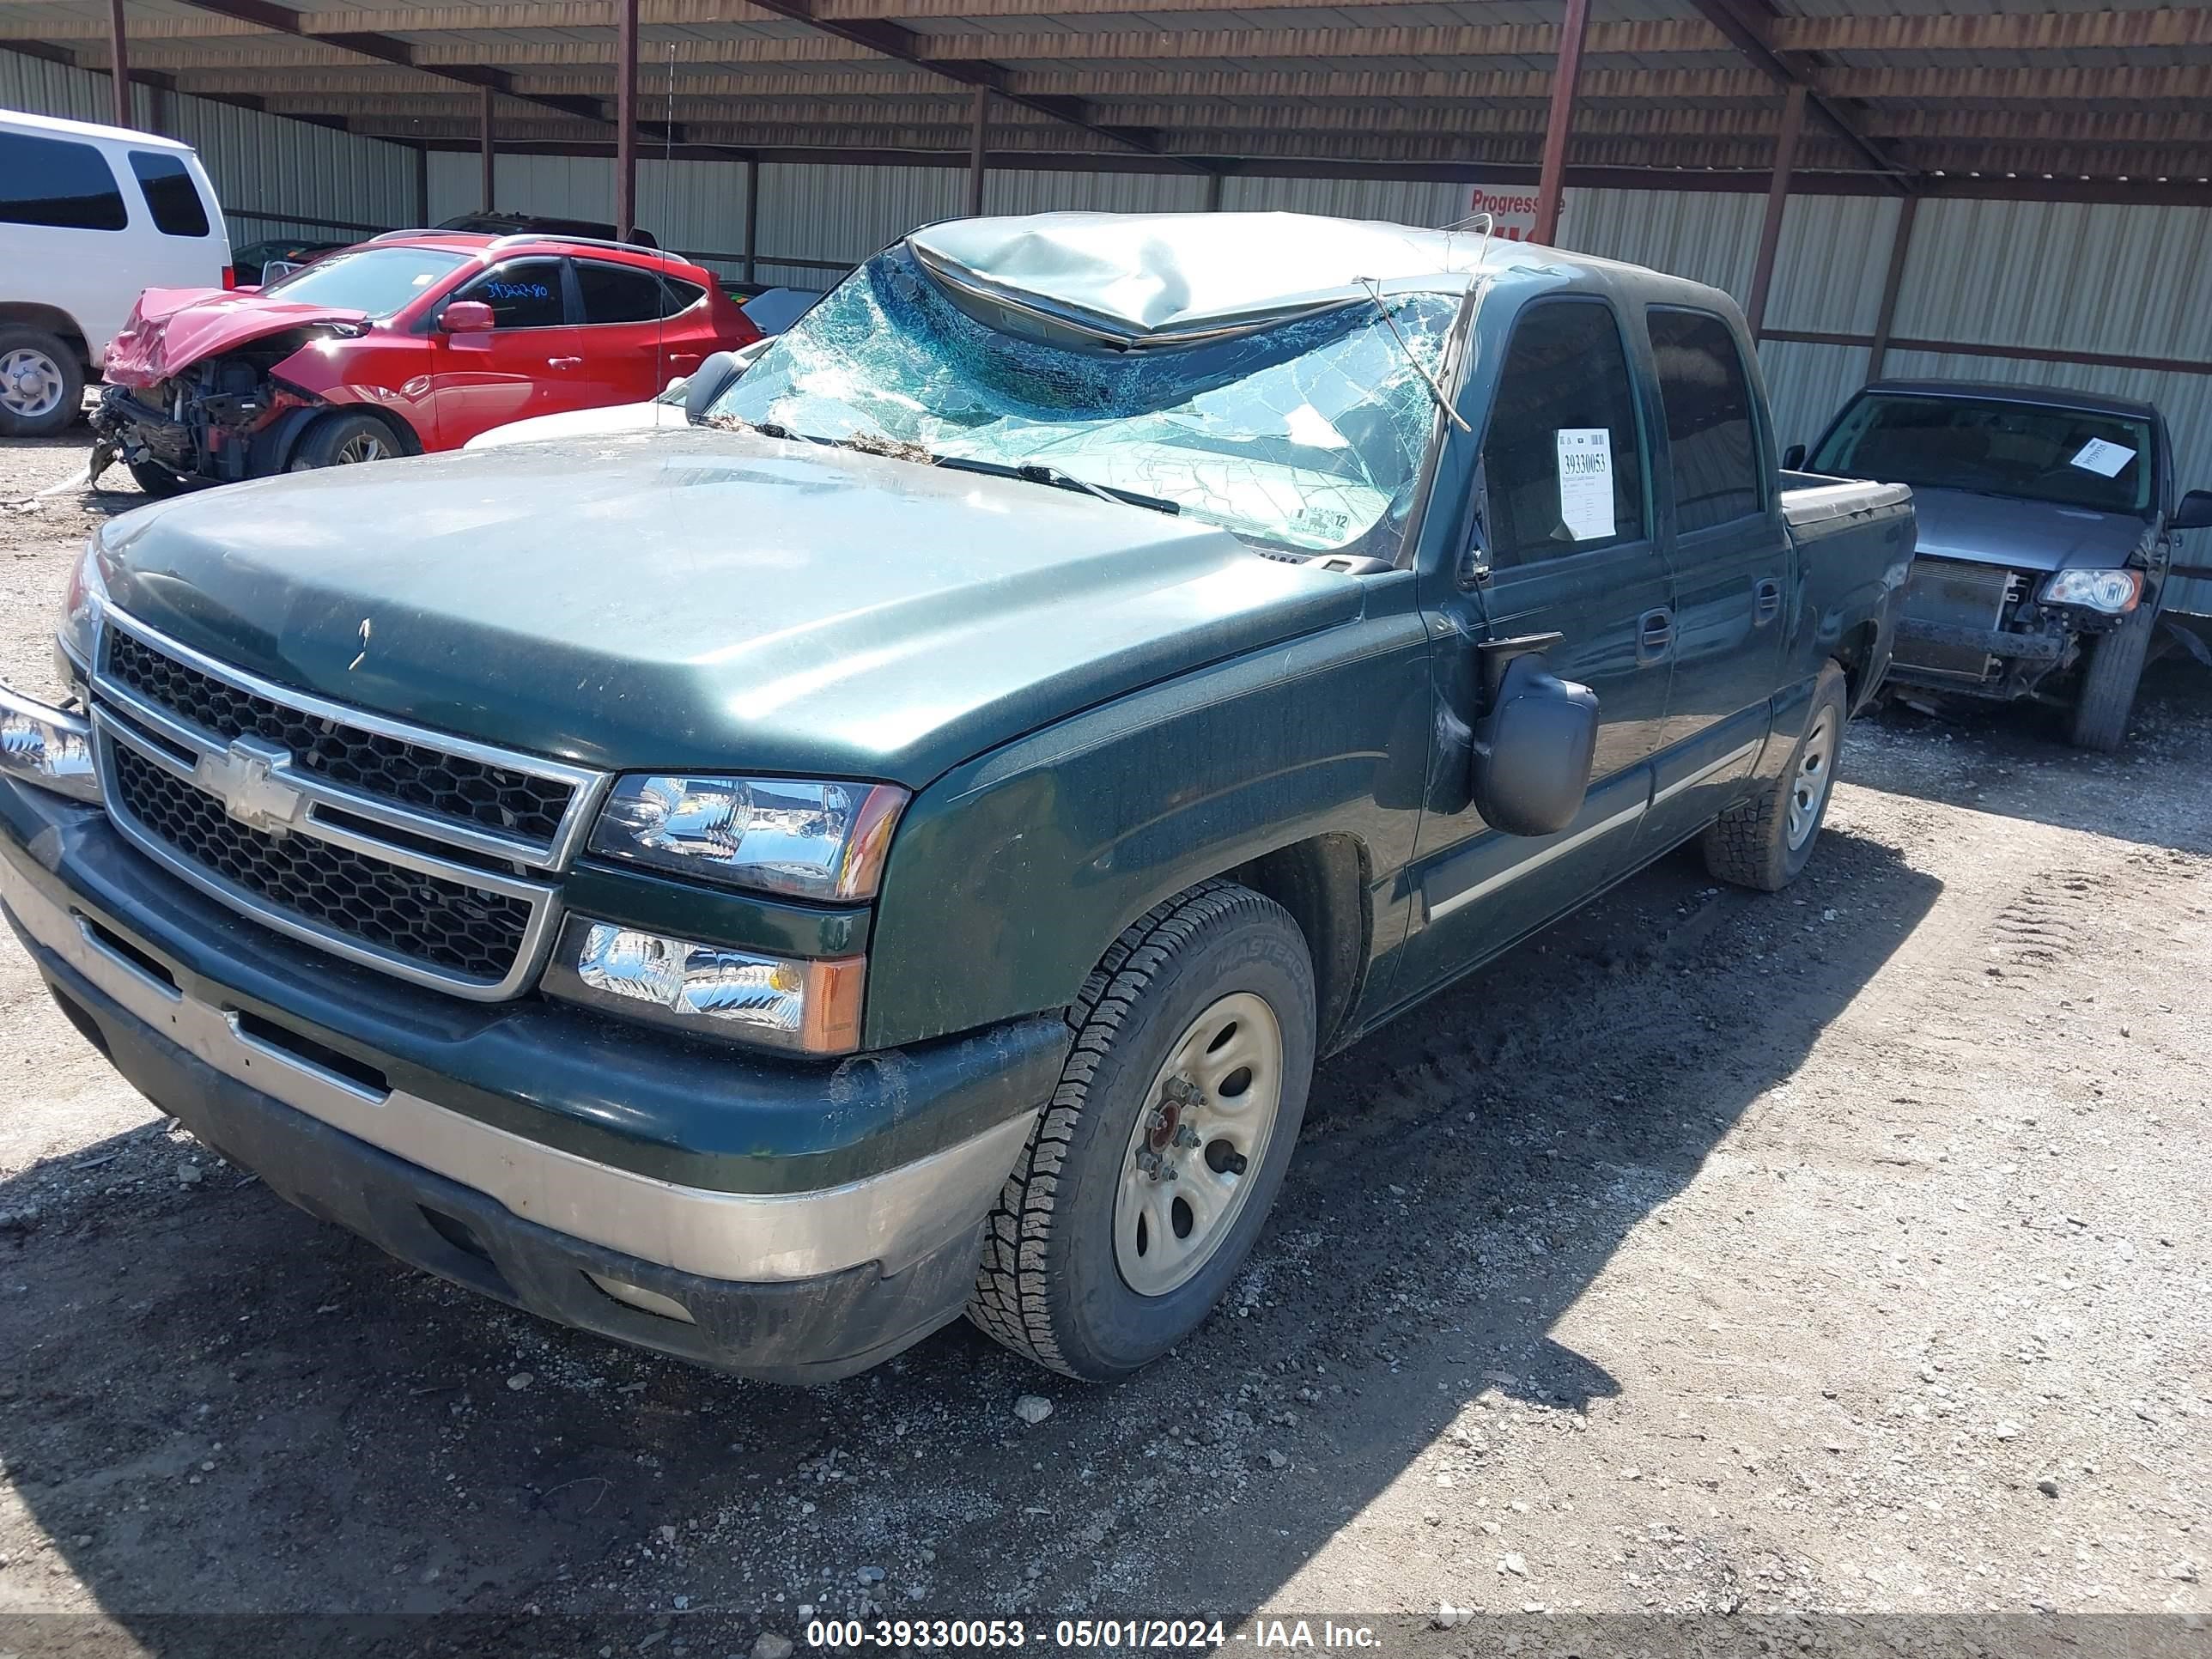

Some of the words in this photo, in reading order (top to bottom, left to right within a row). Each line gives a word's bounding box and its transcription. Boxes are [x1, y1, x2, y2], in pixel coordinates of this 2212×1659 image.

[1471, 189, 1566, 216] Progresse
[1565, 453, 1606, 475] 39330053
[1335, 514, 1348, 528] 12
